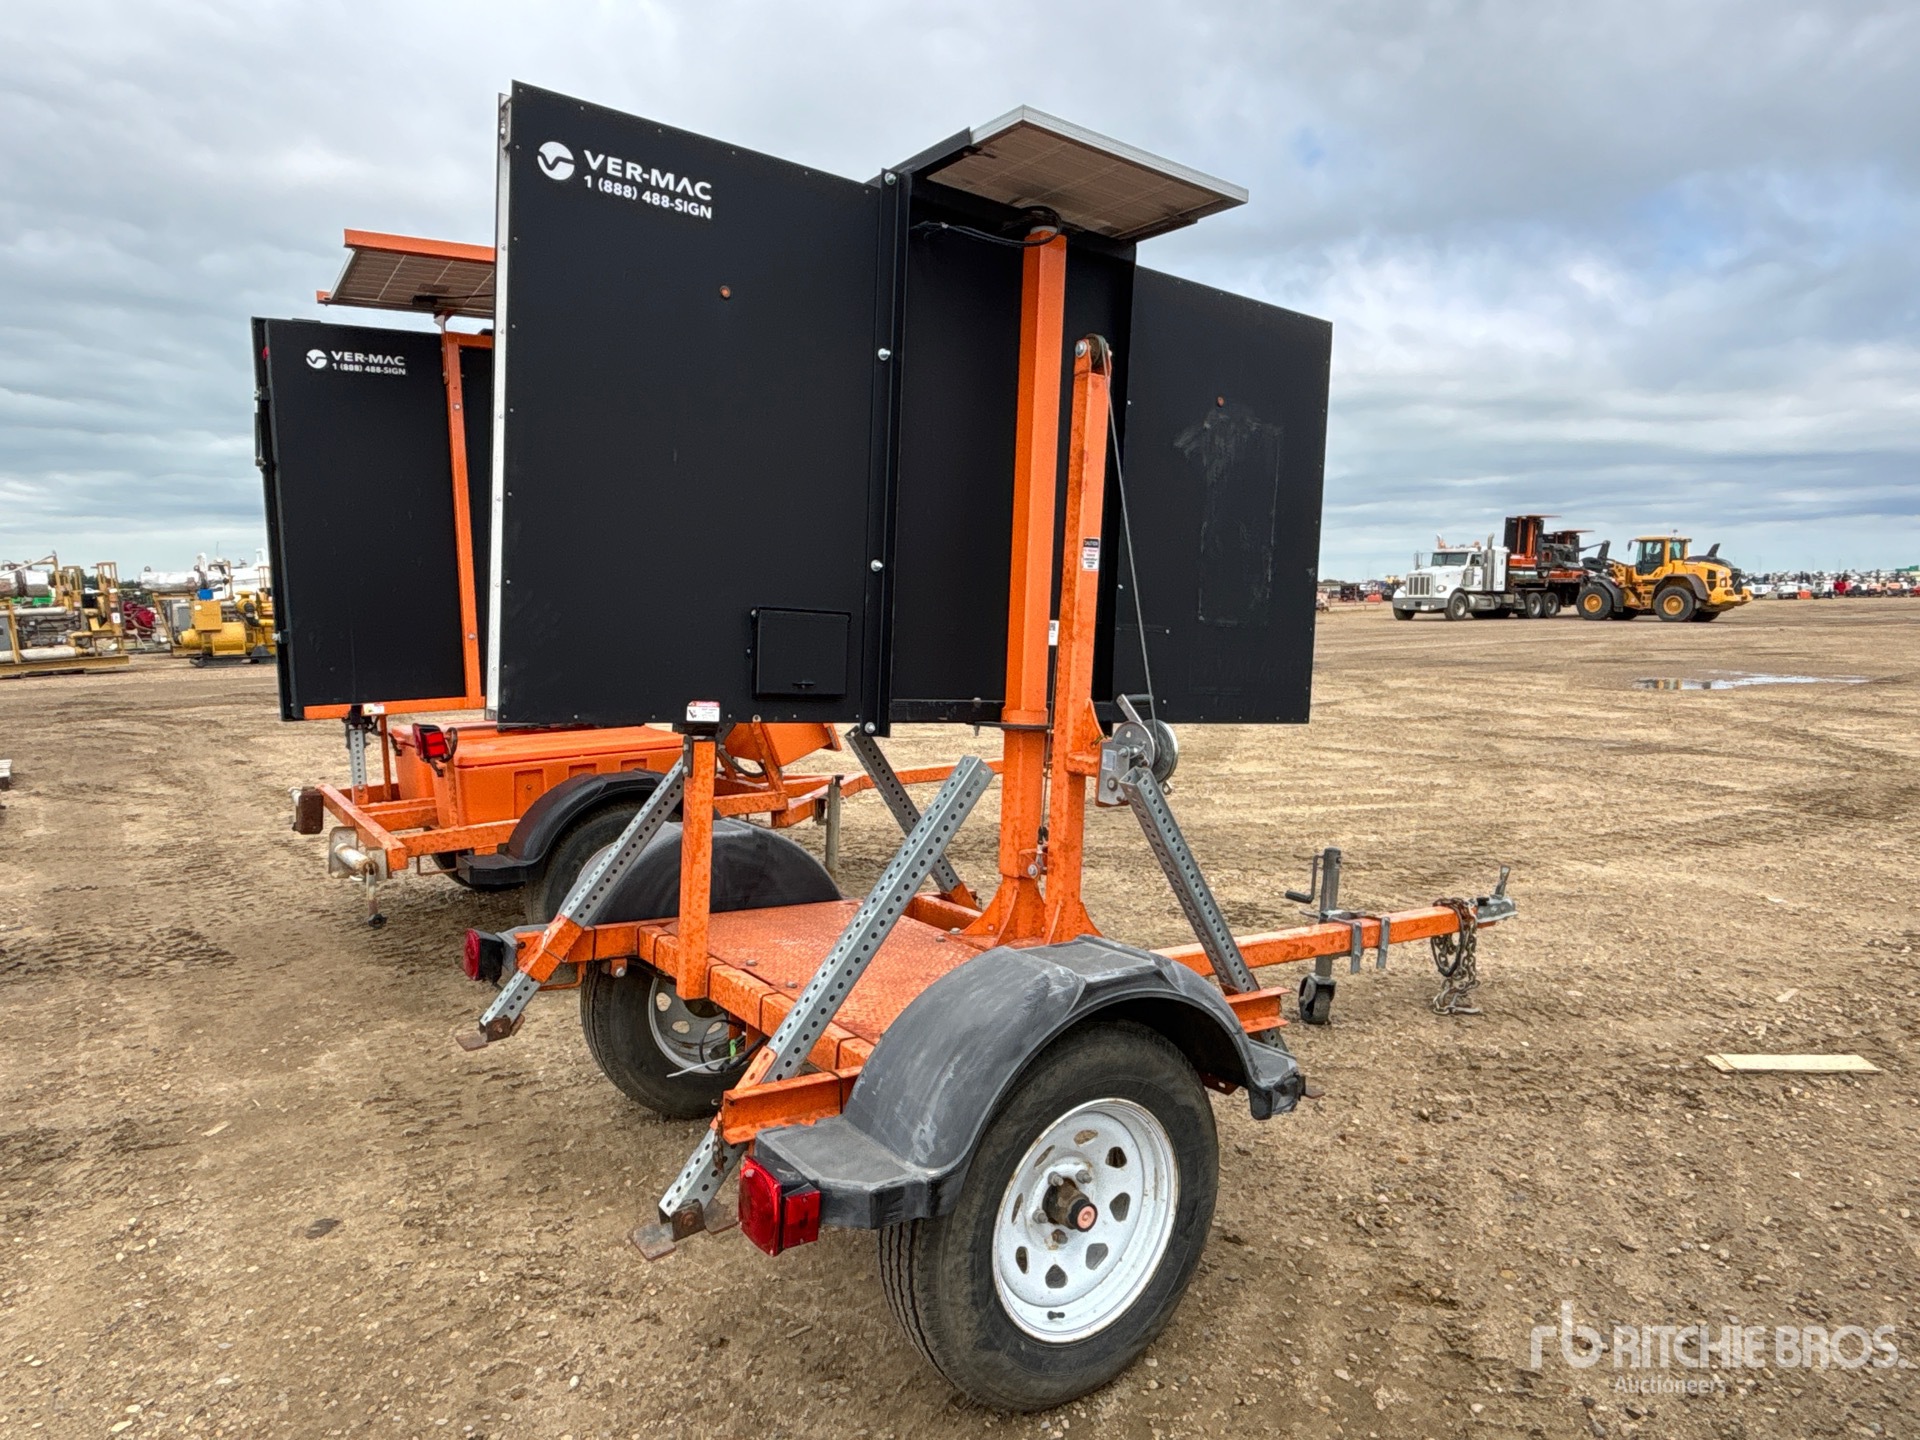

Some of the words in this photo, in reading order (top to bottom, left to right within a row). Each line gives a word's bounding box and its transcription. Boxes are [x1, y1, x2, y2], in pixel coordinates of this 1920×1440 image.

[584, 149, 712, 201] VER-MAC
[584, 175, 592, 188] 1
[598, 177, 638, 200] (888)
[641, 191, 712, 219] 488-SIGN
[331, 350, 405, 366] VER-MAC
[332, 362, 337, 370] 1
